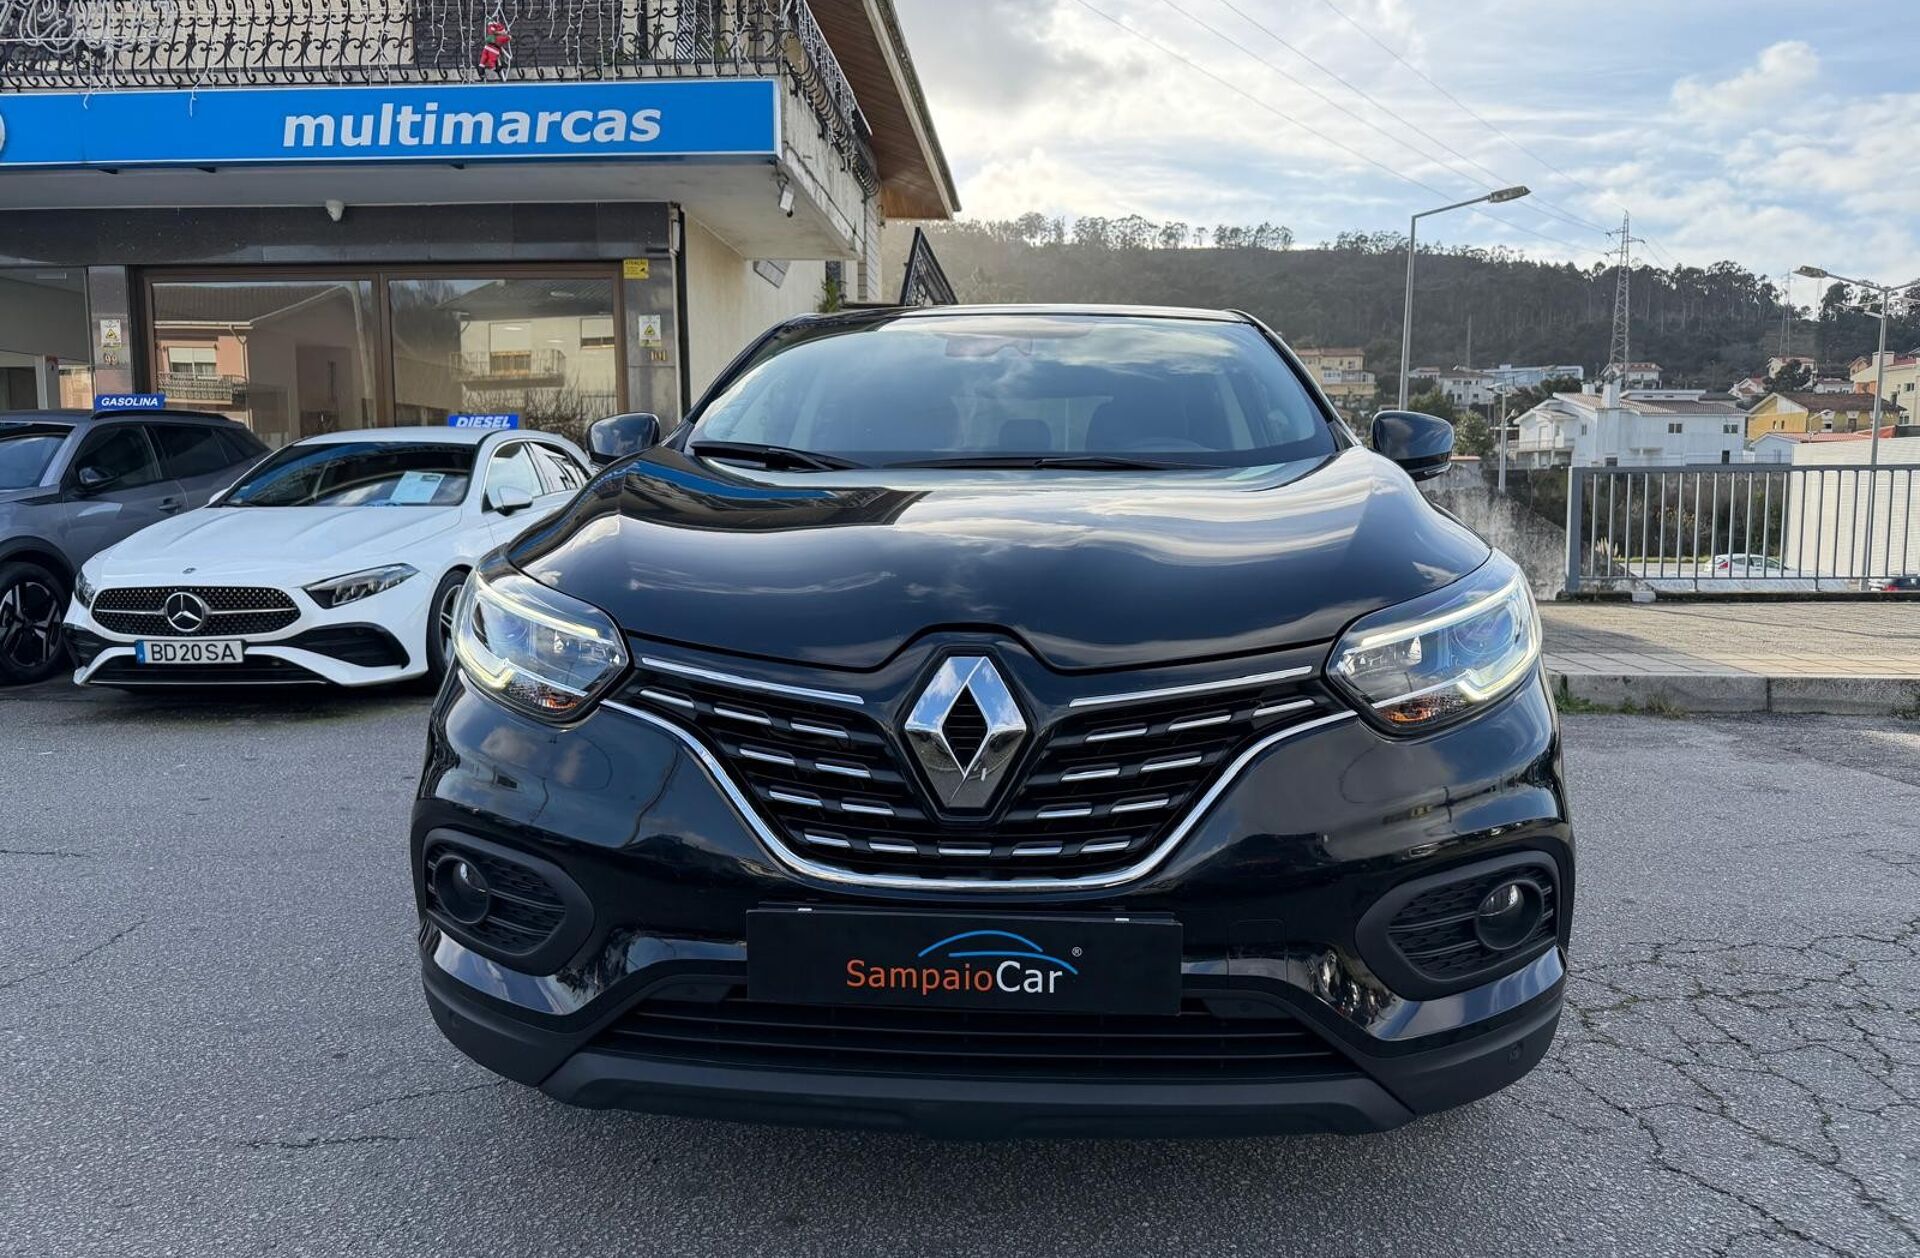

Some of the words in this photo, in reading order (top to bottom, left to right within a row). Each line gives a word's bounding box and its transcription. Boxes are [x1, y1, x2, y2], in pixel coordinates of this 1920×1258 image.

[282, 102, 662, 148] multimarcas
[101, 397, 158, 407] GASOLINA
[456, 415, 511, 428] DIESEL
[846, 959, 1063, 996] SampaioCar
